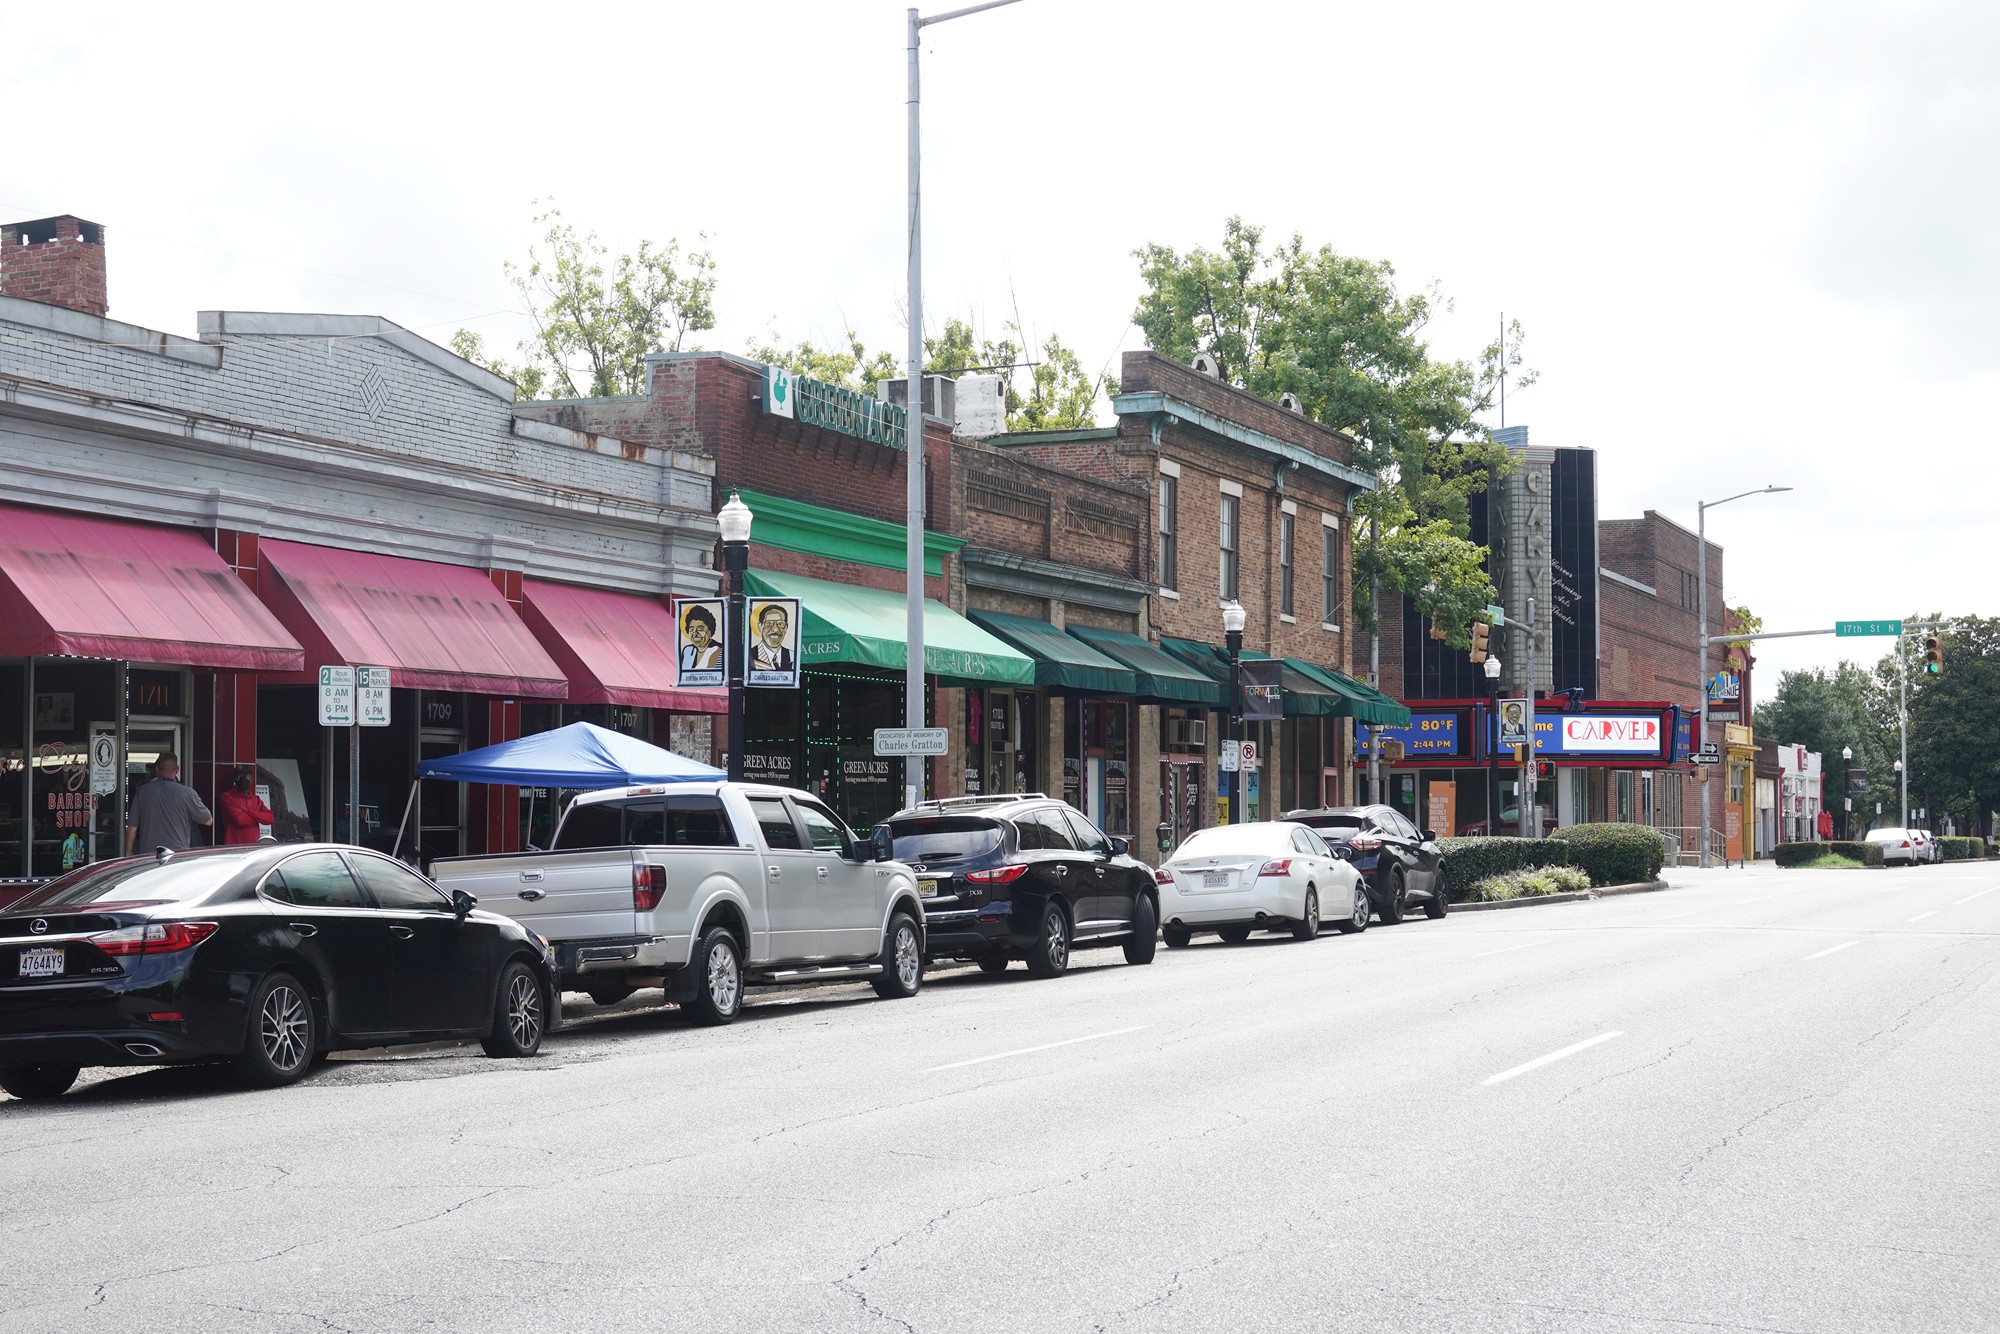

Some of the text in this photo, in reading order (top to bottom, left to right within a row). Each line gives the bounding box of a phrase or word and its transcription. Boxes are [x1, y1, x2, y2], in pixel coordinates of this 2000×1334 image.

[796, 375, 908, 452] GREEN ACR
[1527, 471, 1546, 650] CARVR
[1552, 558, 1573, 578] Carver
[1551, 576, 1582, 600] rforming
[1554, 595, 1570, 608] Arts
[1552, 604, 1575, 625] Theatre
[1843, 623, 1894, 633] 17th St N
[949, 652, 985, 675] ACRES
[322, 669, 329, 684] 2
[359, 670, 387, 685] 15 MINUTE
[371, 678, 388, 686] PARKING
[325, 688, 348, 697] 8 AM
[365, 689, 383, 699] 8 AM
[325, 704, 348, 713] 6 PM
[365, 706, 383, 716] 6 PM
[428, 703, 452, 719] 1709
[992, 709, 1004, 720] 1703
[620, 712, 638, 727] 1707
[1421, 719, 1454, 731] 80°F
[1567, 720, 1656, 741] CARVER
[879, 738, 943, 750] Charles Gratton
[1436, 740, 1451, 748] PM
[40, 741, 89, 791] City
[767, 756, 791, 769] ACRES
[844, 761, 889, 774] GREEN ACRES
[48, 793, 99, 809] BARBER
[56, 810, 91, 828] SHOP
[22, 955, 63, 970] 4764AY9
